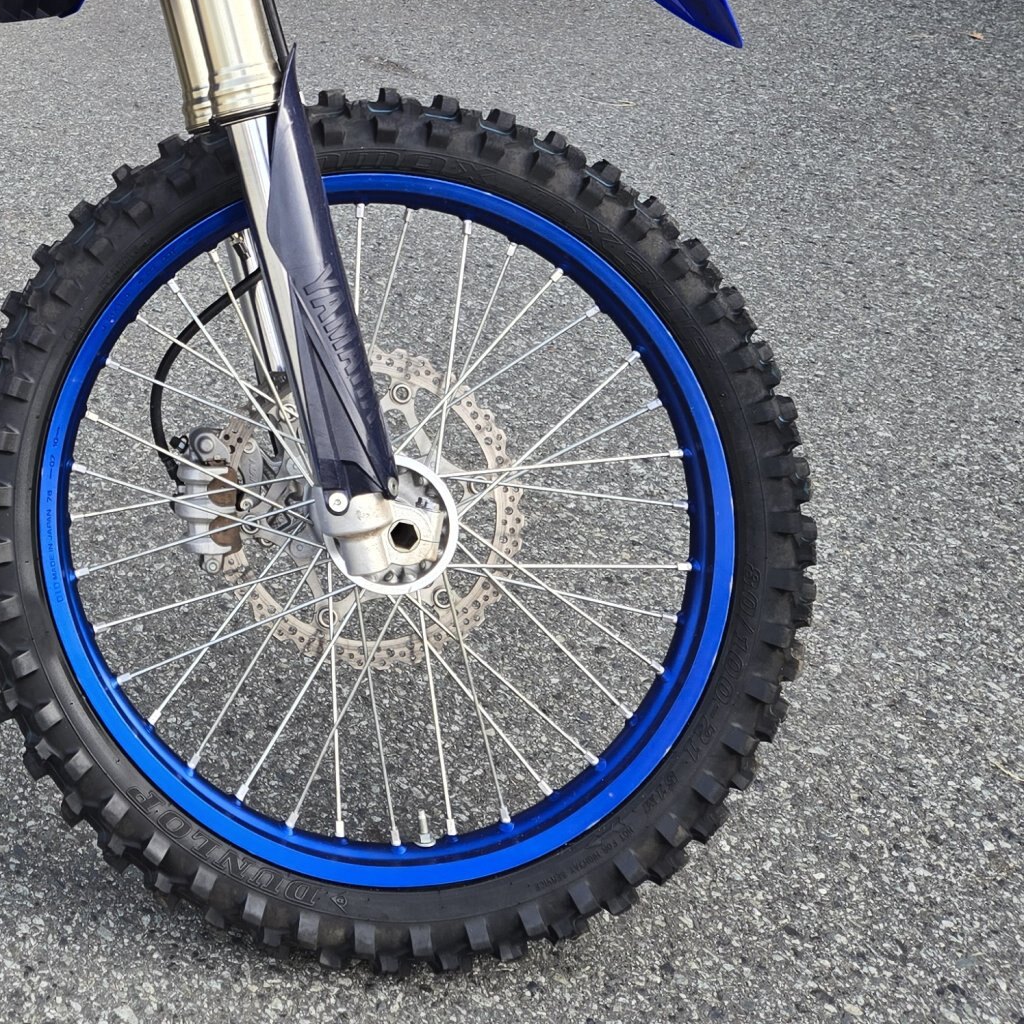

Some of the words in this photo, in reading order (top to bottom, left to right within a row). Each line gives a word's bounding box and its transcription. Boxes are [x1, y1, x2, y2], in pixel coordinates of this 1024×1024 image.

[303, 263, 374, 425] YAMAHA
[51, 553, 59, 581] MADE
[126, 786, 319, 907] DUNLOP
